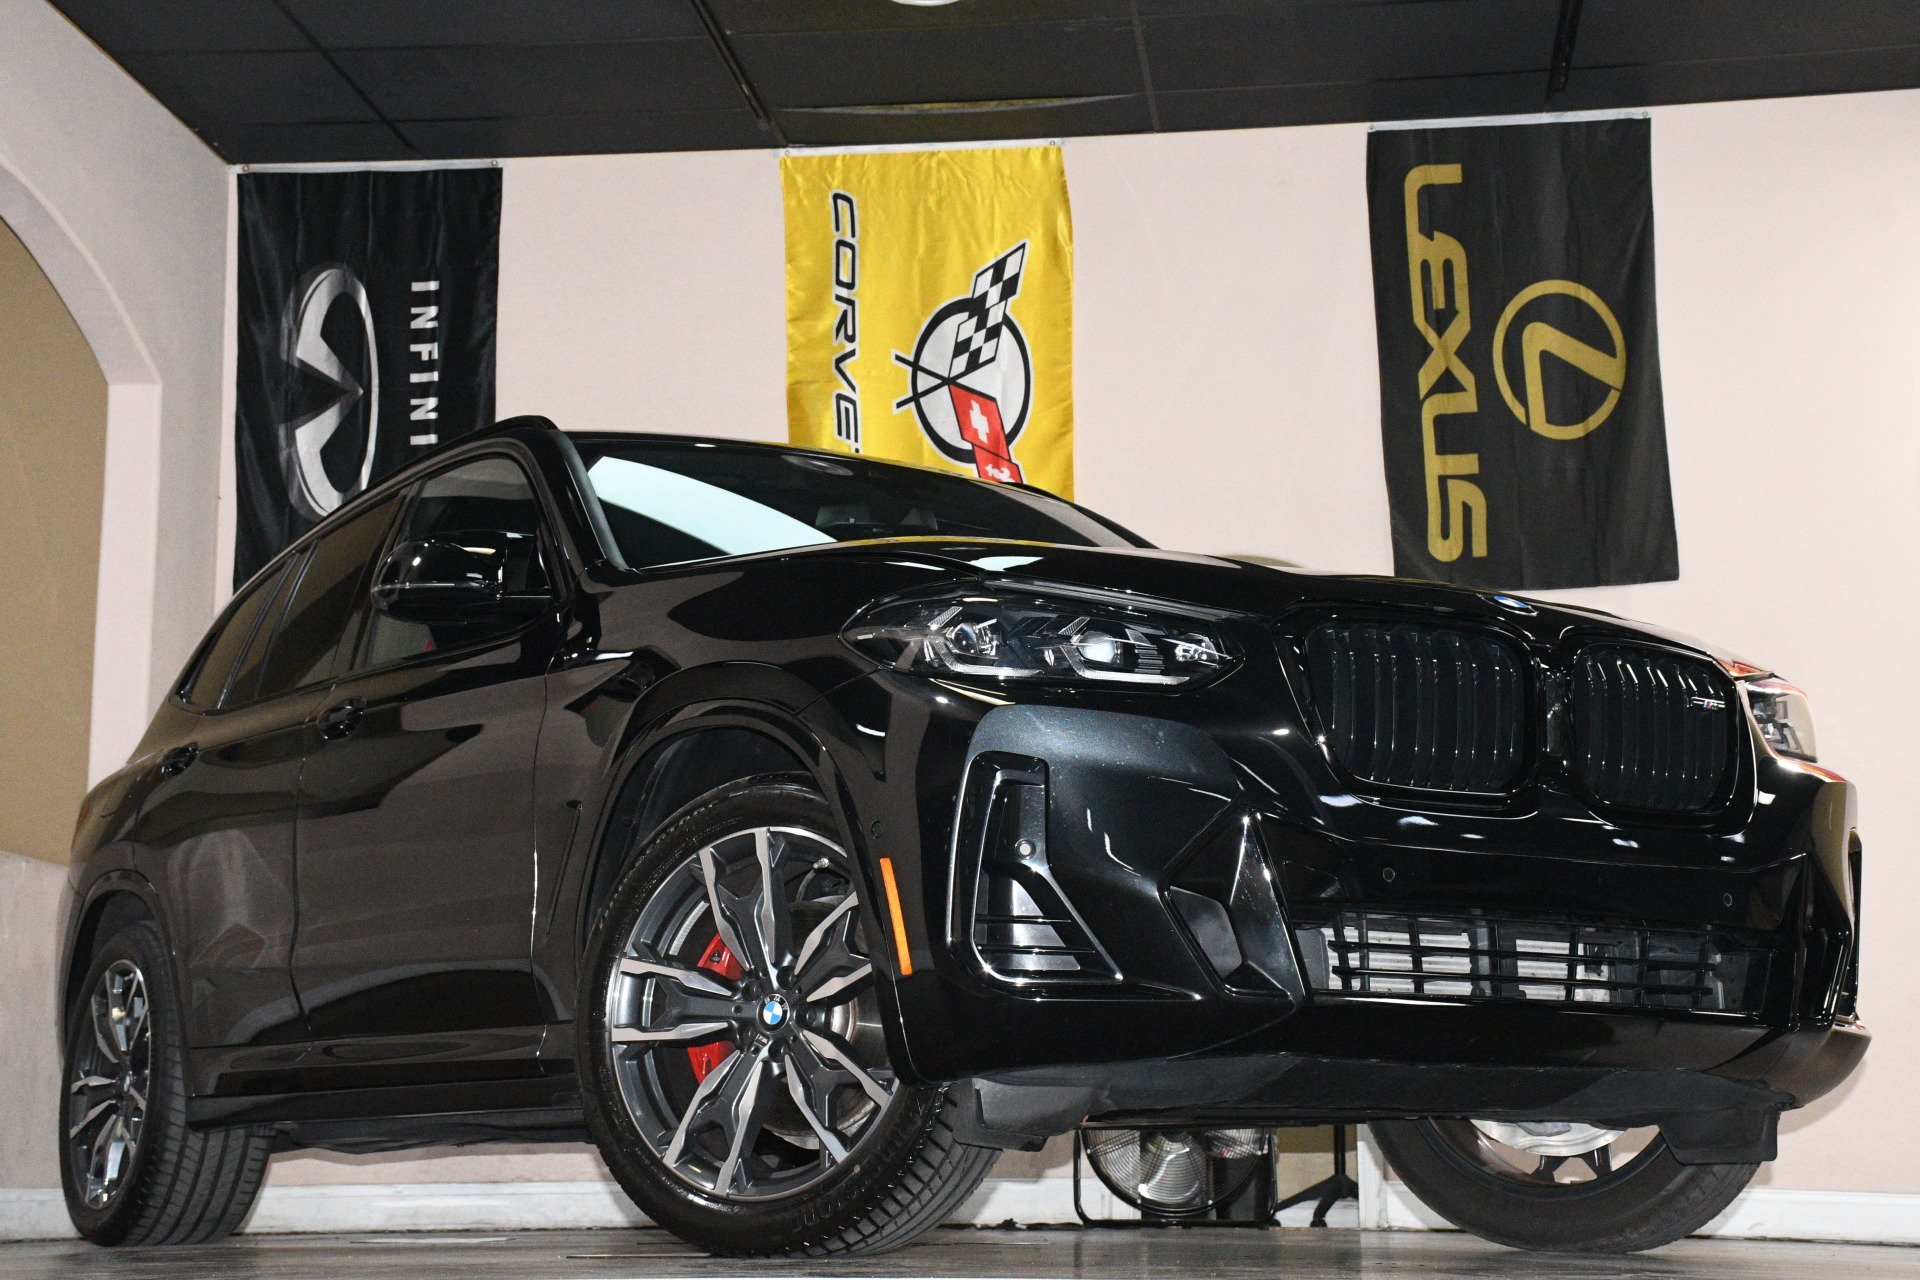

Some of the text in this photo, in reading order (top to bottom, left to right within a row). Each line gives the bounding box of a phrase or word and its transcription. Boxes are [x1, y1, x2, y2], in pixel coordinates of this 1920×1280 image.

[409, 280, 440, 446] INFINI
[830, 189, 862, 453] CORVE
[1404, 163, 1488, 562] LEXUS
